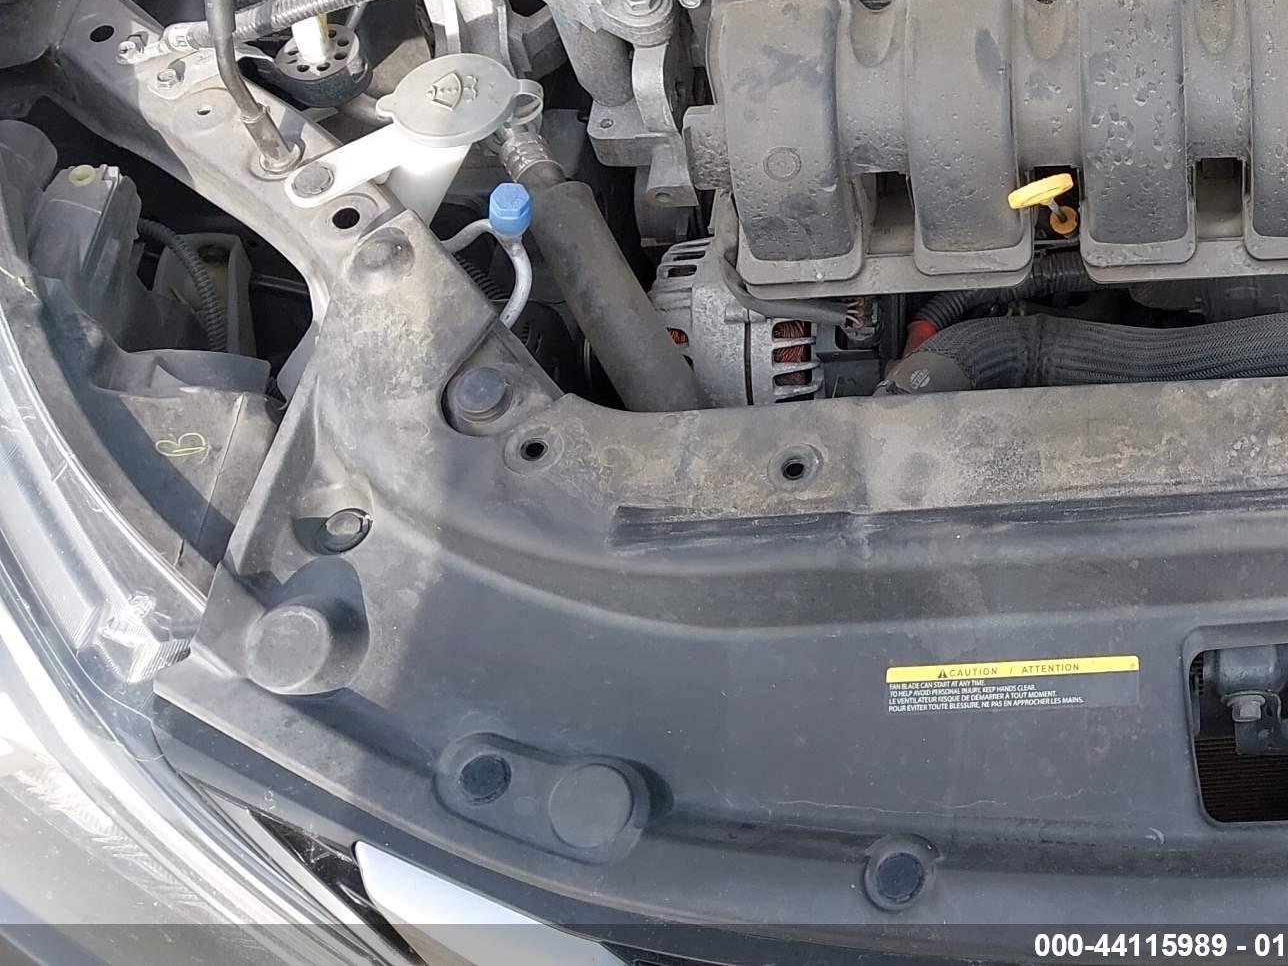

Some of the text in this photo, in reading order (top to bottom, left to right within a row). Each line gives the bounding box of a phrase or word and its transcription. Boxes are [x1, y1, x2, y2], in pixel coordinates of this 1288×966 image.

[949, 667, 998, 678] CAUTION
[1021, 663, 1080, 674] ATTENTION
[897, 696, 938, 704] VENTILATEUR
[938, 695, 960, 703] RISQUE
[1010, 690, 1028, 698] TOUT
[1012, 698, 1050, 706] APPROCHER
